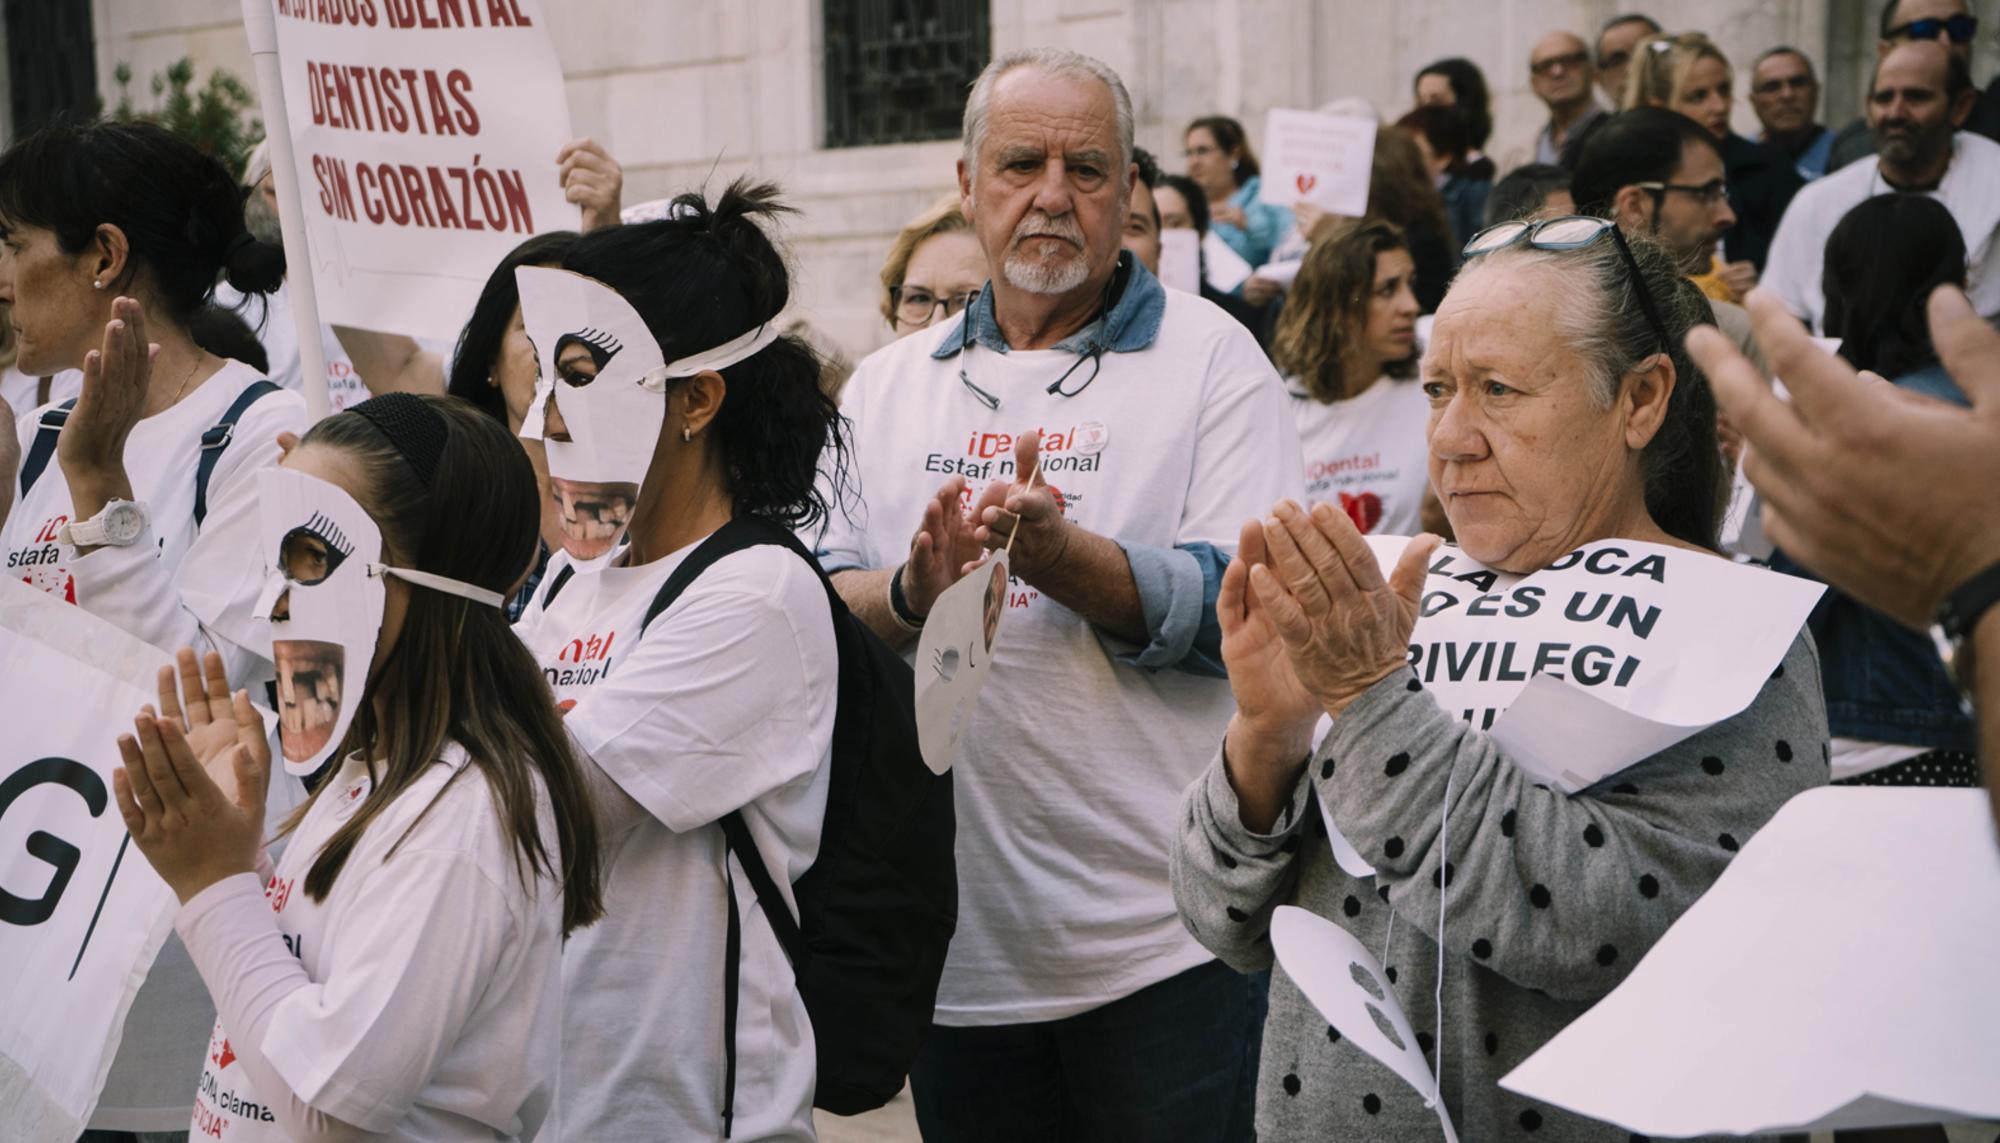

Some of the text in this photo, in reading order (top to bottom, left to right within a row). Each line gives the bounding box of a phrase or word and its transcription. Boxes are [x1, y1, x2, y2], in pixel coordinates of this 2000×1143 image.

[307, 61, 481, 136] DENTISTAS
[312, 154, 535, 235] SIN CORAZÓN
[925, 450, 1102, 480] Estaf nional
[967, 426, 1076, 459] iDetal
[7, 543, 60, 568] stafa
[1428, 547, 1667, 593] LA OCA
[1420, 585, 1663, 640] O ES UN
[559, 631, 615, 664] ntal
[1407, 641, 1641, 687] RIVILEGI
